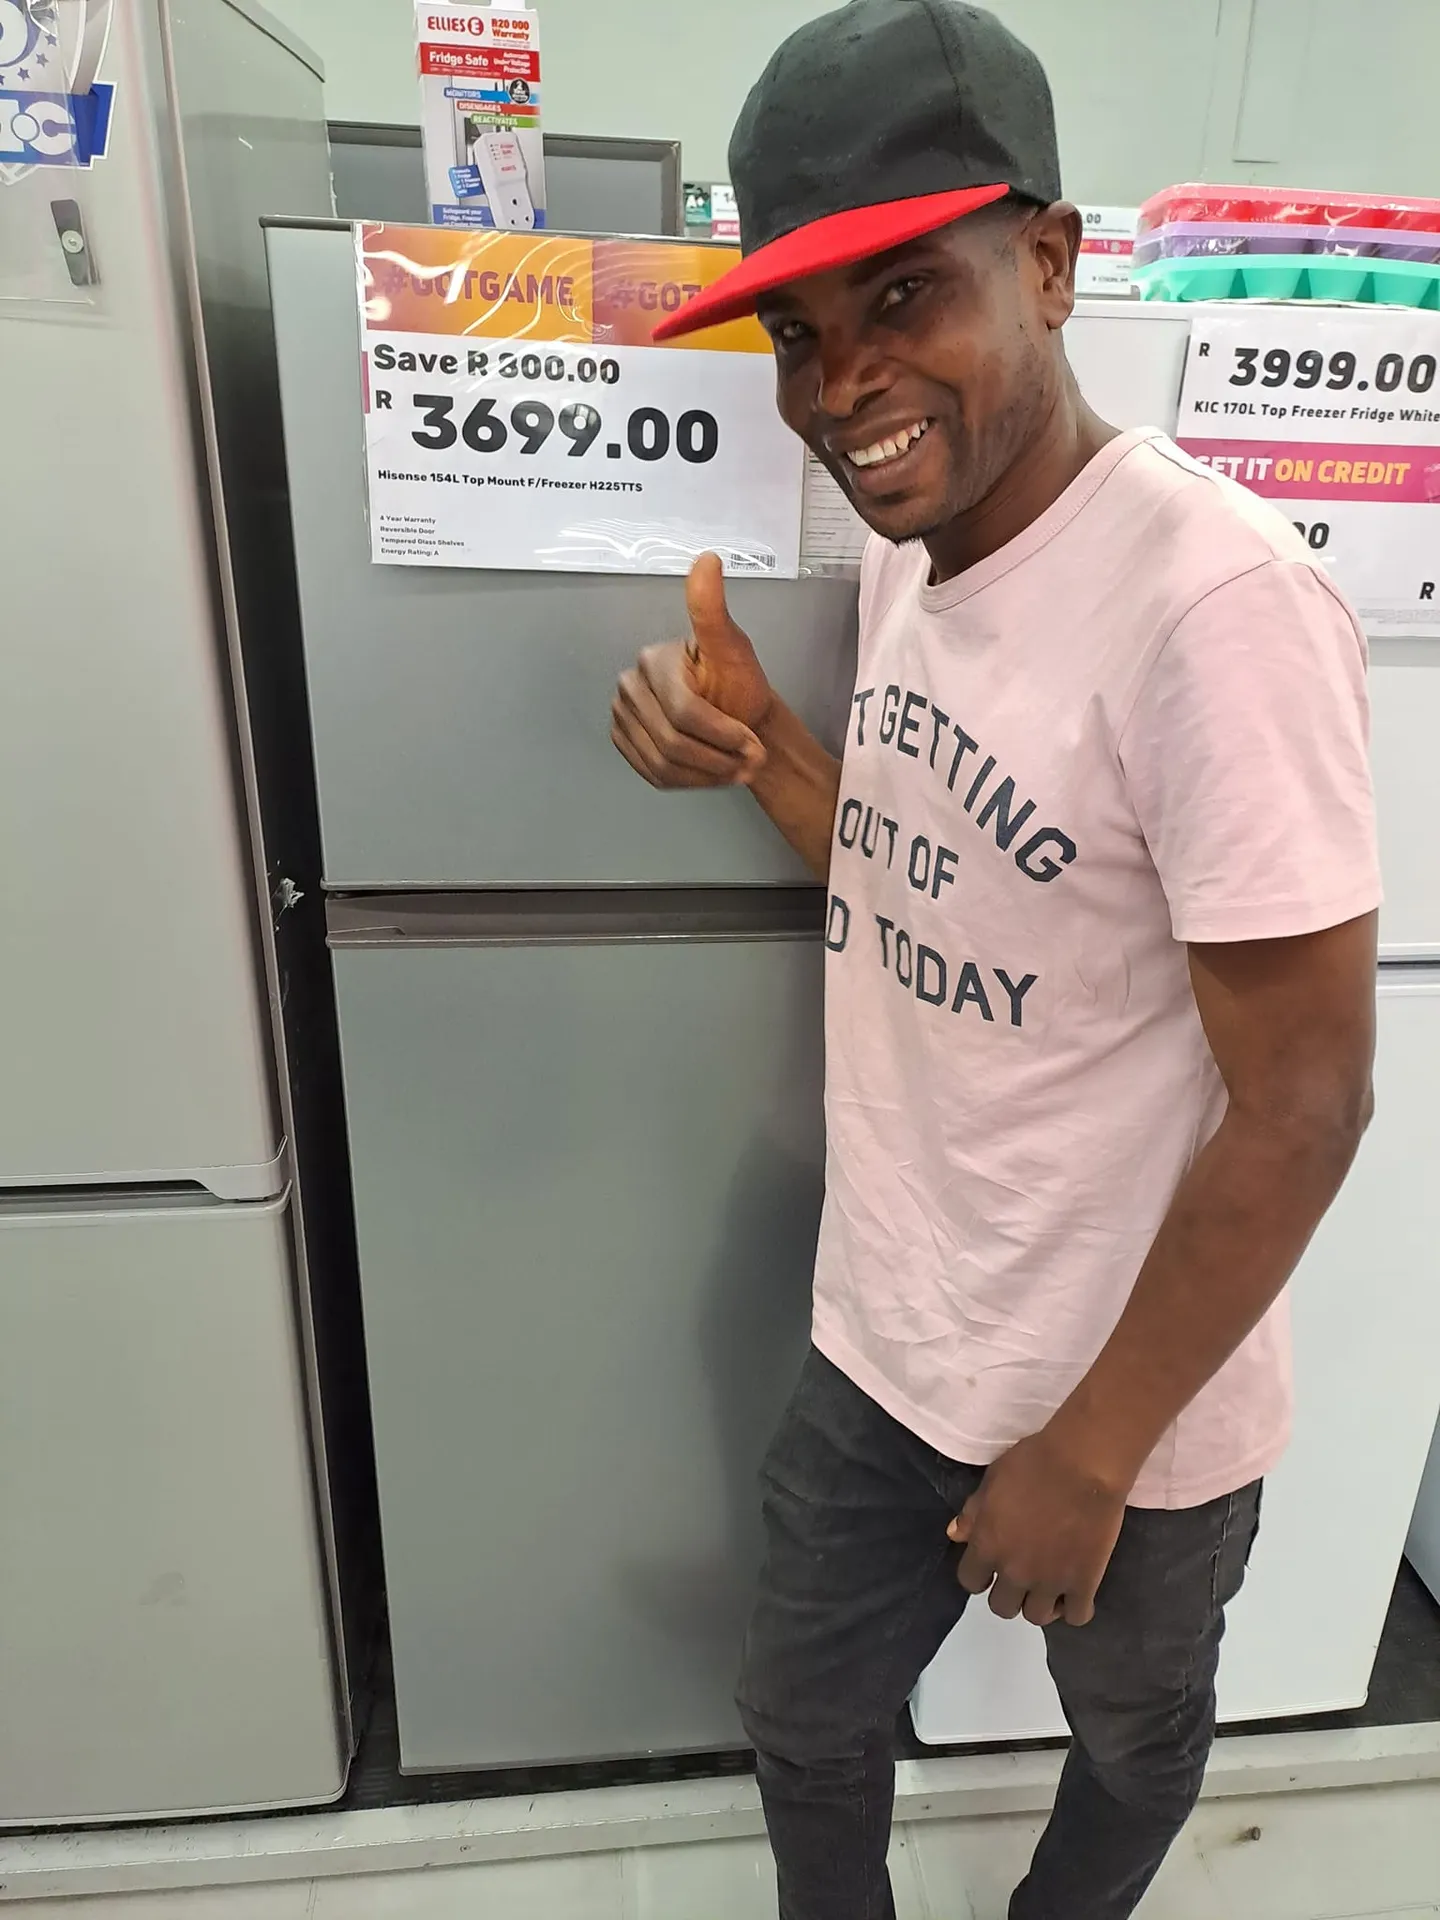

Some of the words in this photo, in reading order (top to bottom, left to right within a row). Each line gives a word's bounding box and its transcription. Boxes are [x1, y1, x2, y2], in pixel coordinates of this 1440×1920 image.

[427, 16, 466, 33] ELLIES
[491, 18, 509, 29] R20
[512, 20, 530, 30] 000
[492, 28, 529, 41] Warranty
[429, 51, 463, 66] Fridge
[465, 53, 489, 66] Safe
[445, 89, 482, 98] MONITORS
[459, 102, 501, 112] DISENGAGES
[473, 115, 518, 126] REACTIVATES
[381, 263, 574, 306] #GOTGAME
[374, 344, 458, 375] Save
[467, 350, 489, 377] R
[1199, 342, 1210, 357] R
[1228, 347, 1437, 394] 3999.00
[1194, 401, 1219, 413] KIC
[1223, 402, 1256, 415] 170L
[1261, 403, 1287, 419] Top
[1291, 405, 1347, 419] Freezer
[1350, 407, 1394, 423] Fridge
[1400, 408, 1440, 422] White
[376, 390, 392, 409] R
[412, 393, 719, 464] 3699.00
[1245, 457, 1273, 480] IT
[1275, 458, 1313, 482] ON
[1317, 460, 1411, 485] CREDIT
[378, 469, 427, 481] Hisense
[430, 472, 460, 483] 154L
[462, 474, 485, 486] Top
[487, 476, 525, 487] Mount
[528, 477, 587, 490] F/Freezer
[589, 480, 643, 492] H225TTS
[403, 516, 436, 524] Warranty
[380, 526, 417, 534] Reversible
[381, 537, 416, 545] Tempered
[408, 549, 432, 557] Rating:
[1419, 582, 1435, 600] R
[879, 684, 1078, 883] GETTING
[838, 798, 899, 871] OUT
[907, 834, 959, 900] OF
[875, 913, 1039, 1028] TODAY
